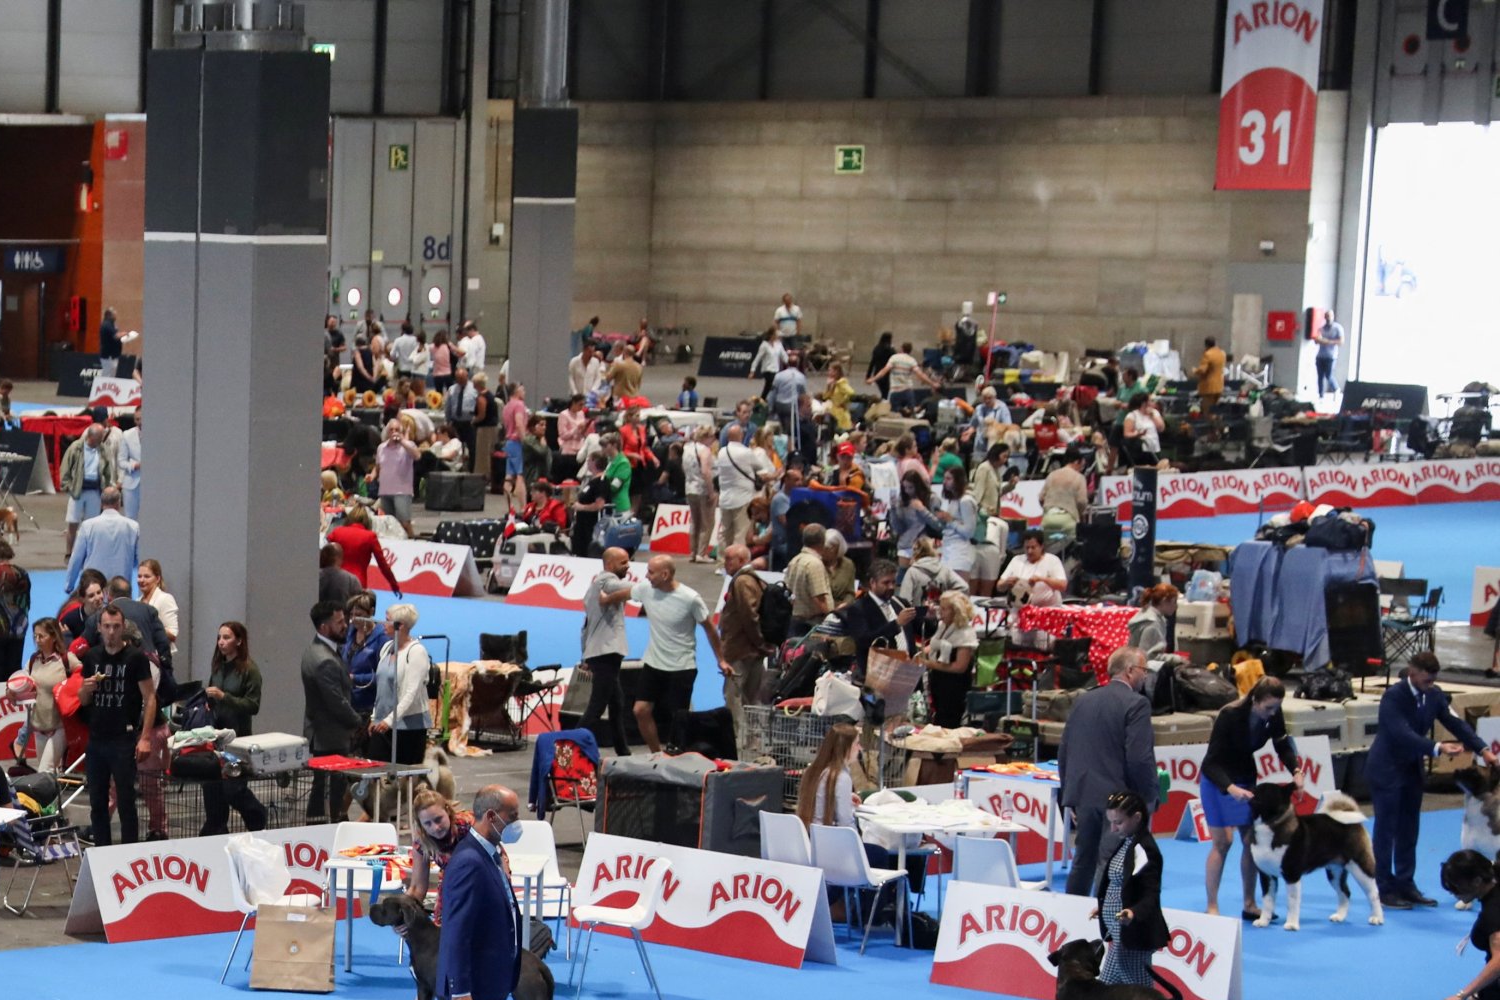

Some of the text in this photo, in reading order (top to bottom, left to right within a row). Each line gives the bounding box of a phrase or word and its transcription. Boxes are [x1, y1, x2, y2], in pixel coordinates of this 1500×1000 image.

[1232, 1, 1320, 45] ARION
[1238, 109, 1292, 165] 31
[423, 236, 453, 261] 8d
[95, 382, 121, 396] ARION
[1211, 471, 1300, 497] RION ARION
[1309, 467, 1411, 493] ARION ARION
[1412, 463, 1461, 487] ARION
[1105, 479, 1132, 505] ARI
[1160, 475, 1210, 503] ARION
[655, 511, 691, 535] ARI
[411, 551, 457, 575] ARION
[523, 562, 574, 588] ARION
[110, 855, 210, 905] ARION
[708, 873, 802, 924] ARION
[957, 903, 1069, 955] ARION
